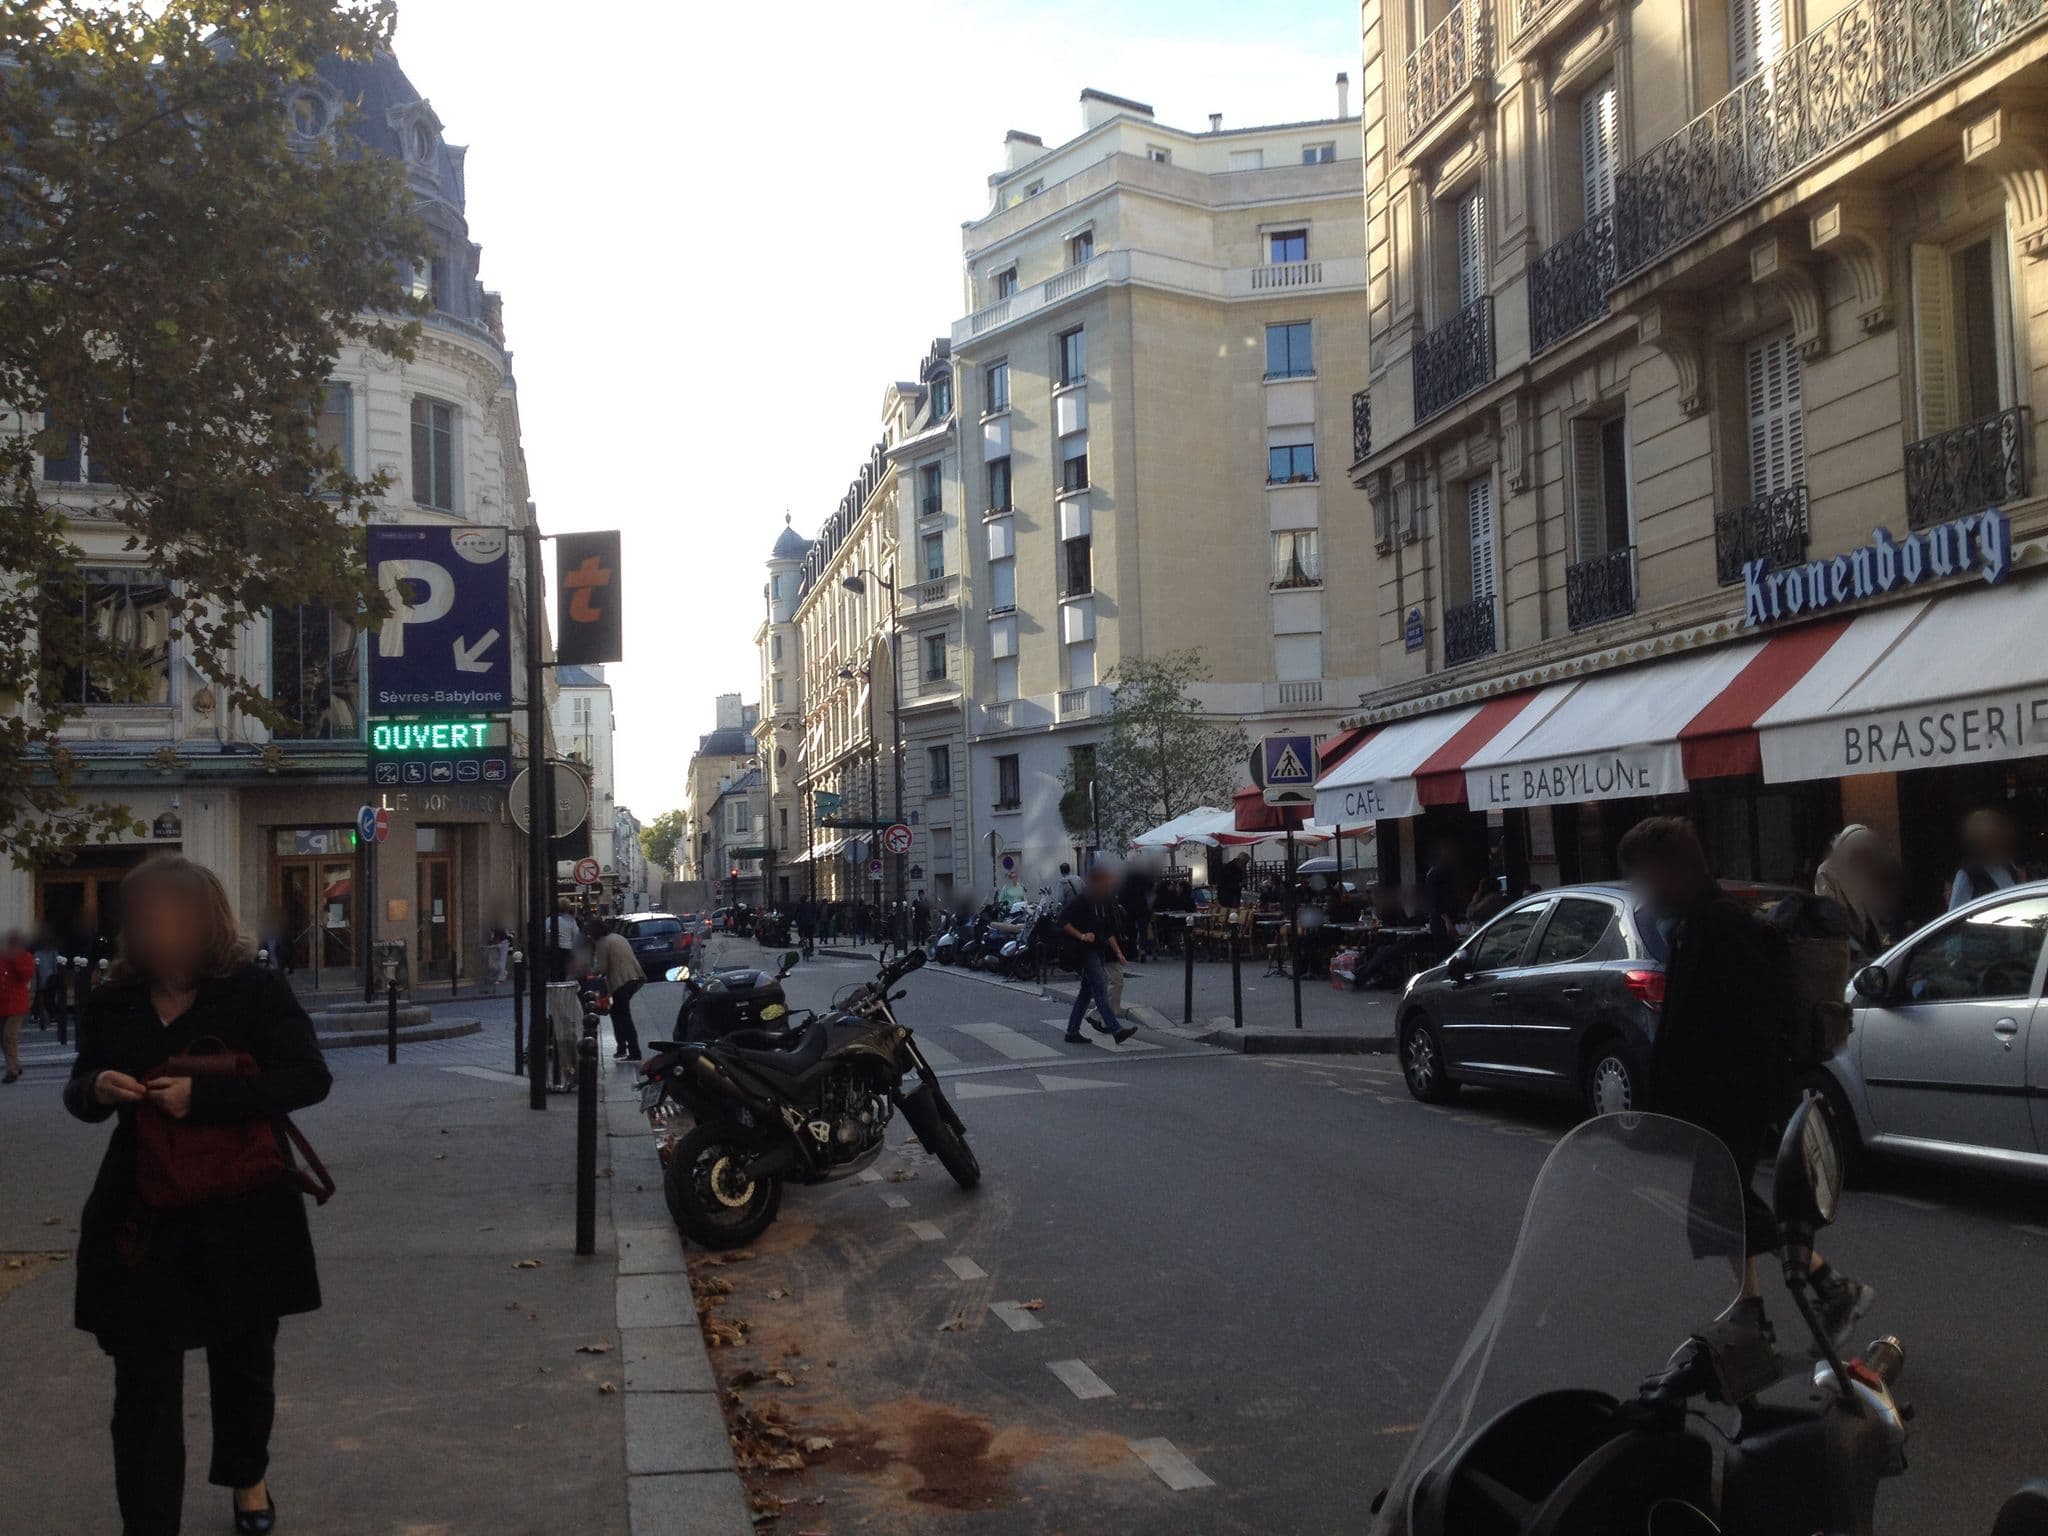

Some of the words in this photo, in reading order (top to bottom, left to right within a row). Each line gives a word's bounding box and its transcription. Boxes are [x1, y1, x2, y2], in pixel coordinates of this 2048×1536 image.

[561, 554, 611, 623] t
[1743, 507, 2011, 628] Kronenbourg
[378, 559, 455, 658] P
[379, 690, 502, 704] Sèvres-Babylone
[373, 723, 488, 750] OUVERT
[1490, 773, 1510, 802] LE
[1524, 758, 1651, 800] BABYLONE
